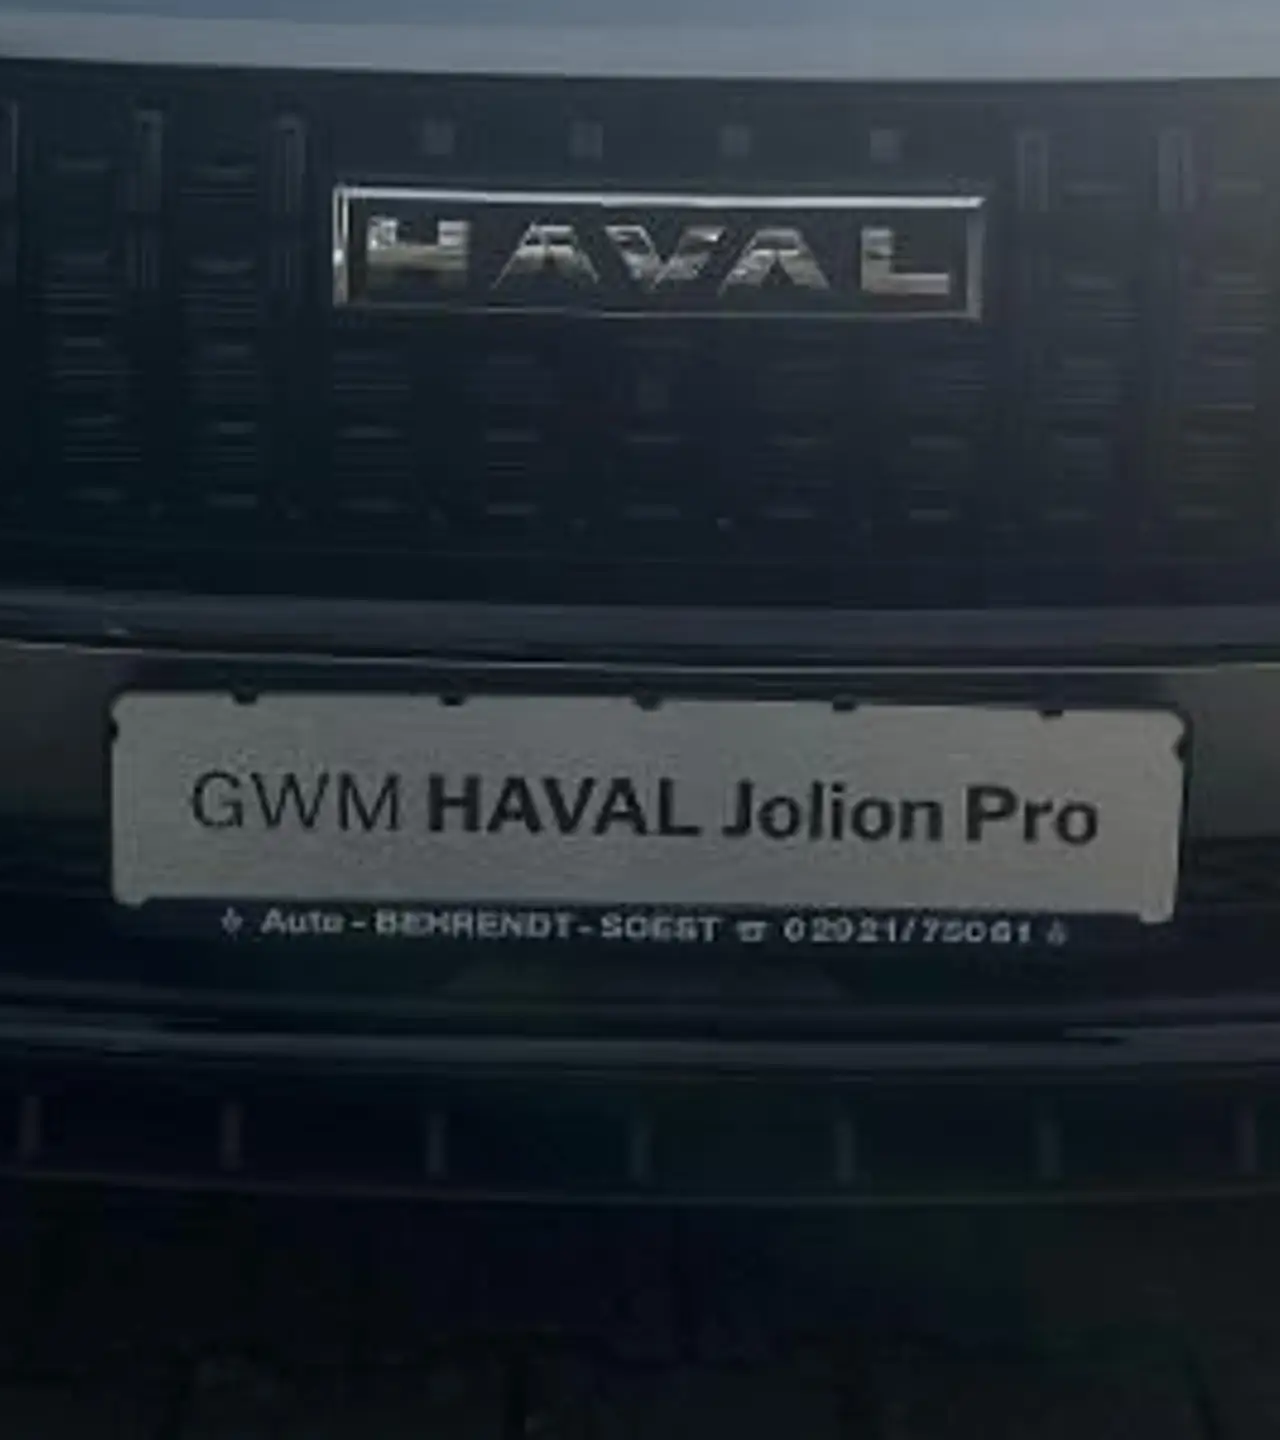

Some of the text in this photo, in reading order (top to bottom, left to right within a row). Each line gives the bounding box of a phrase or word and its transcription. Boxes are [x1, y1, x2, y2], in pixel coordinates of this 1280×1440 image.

[366, 216, 950, 295] HAVAL
[190, 769, 1100, 846] GWM HAVAL Jolion Pro
